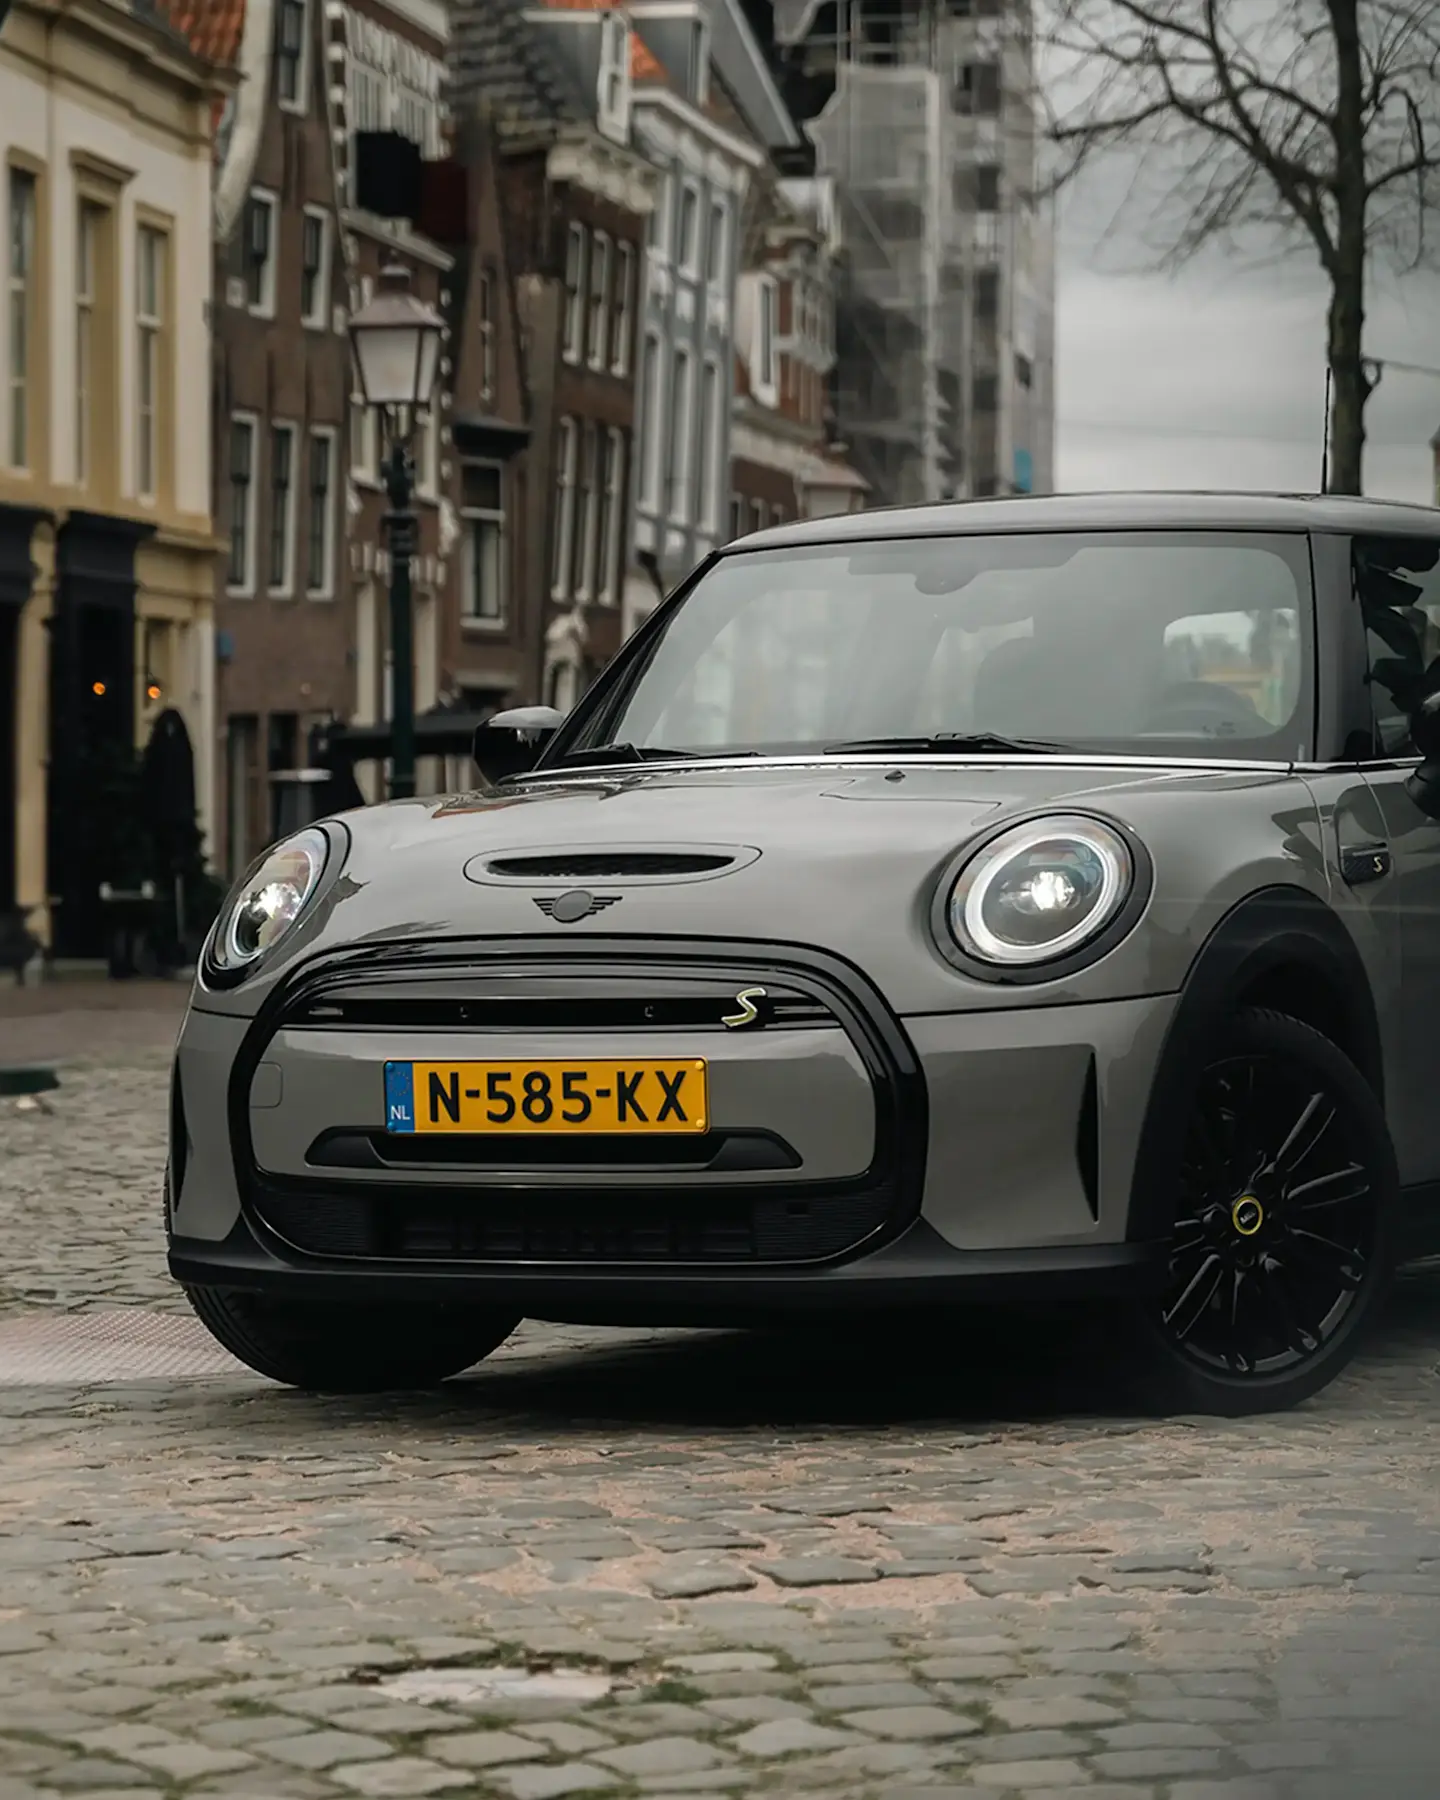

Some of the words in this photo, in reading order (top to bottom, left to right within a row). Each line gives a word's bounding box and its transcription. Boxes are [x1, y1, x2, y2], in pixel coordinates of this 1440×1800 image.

[1373, 856, 1383, 873] S
[721, 987, 766, 1028] S
[428, 1071, 689, 1123] N-585-KX
[390, 1105, 411, 1120] NL
